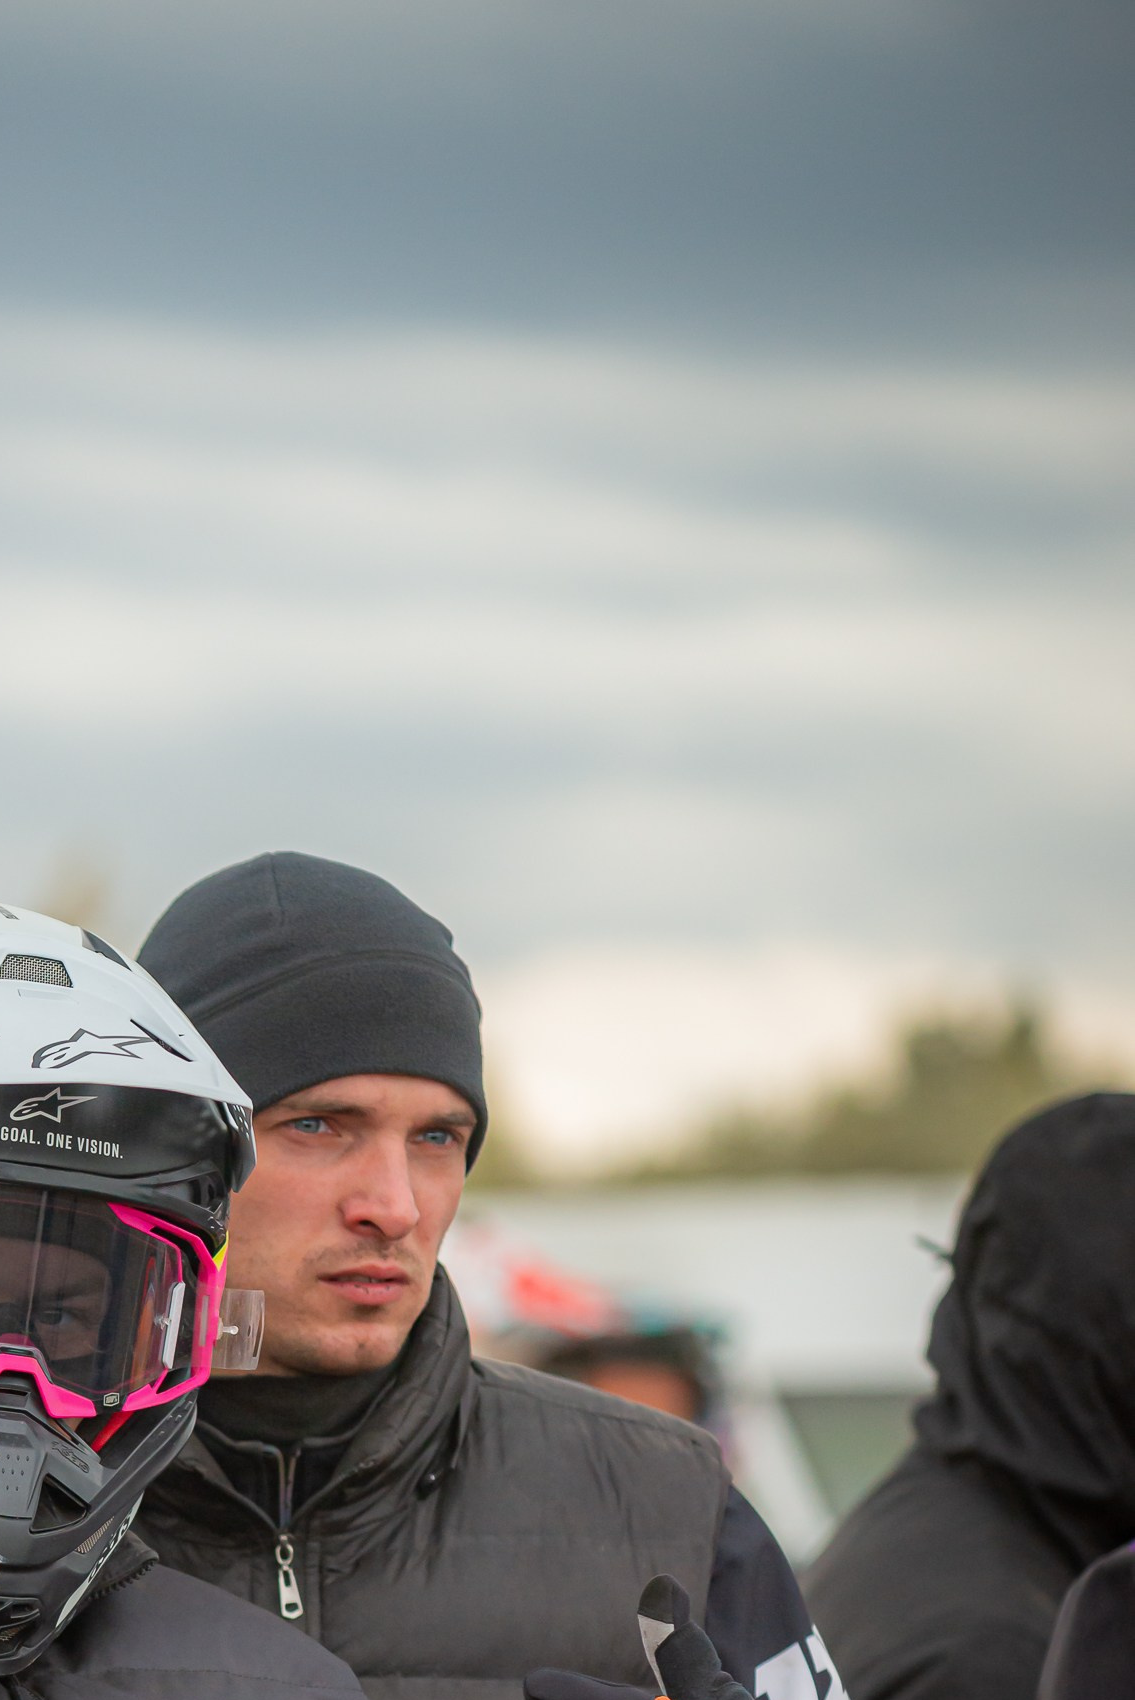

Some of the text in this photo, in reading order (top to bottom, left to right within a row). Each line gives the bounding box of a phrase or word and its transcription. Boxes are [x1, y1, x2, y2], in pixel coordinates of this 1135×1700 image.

[0, 1126, 41, 1145] GOAL.
[46, 1131, 72, 1150] ONE
[76, 1136, 124, 1159] VISION.
